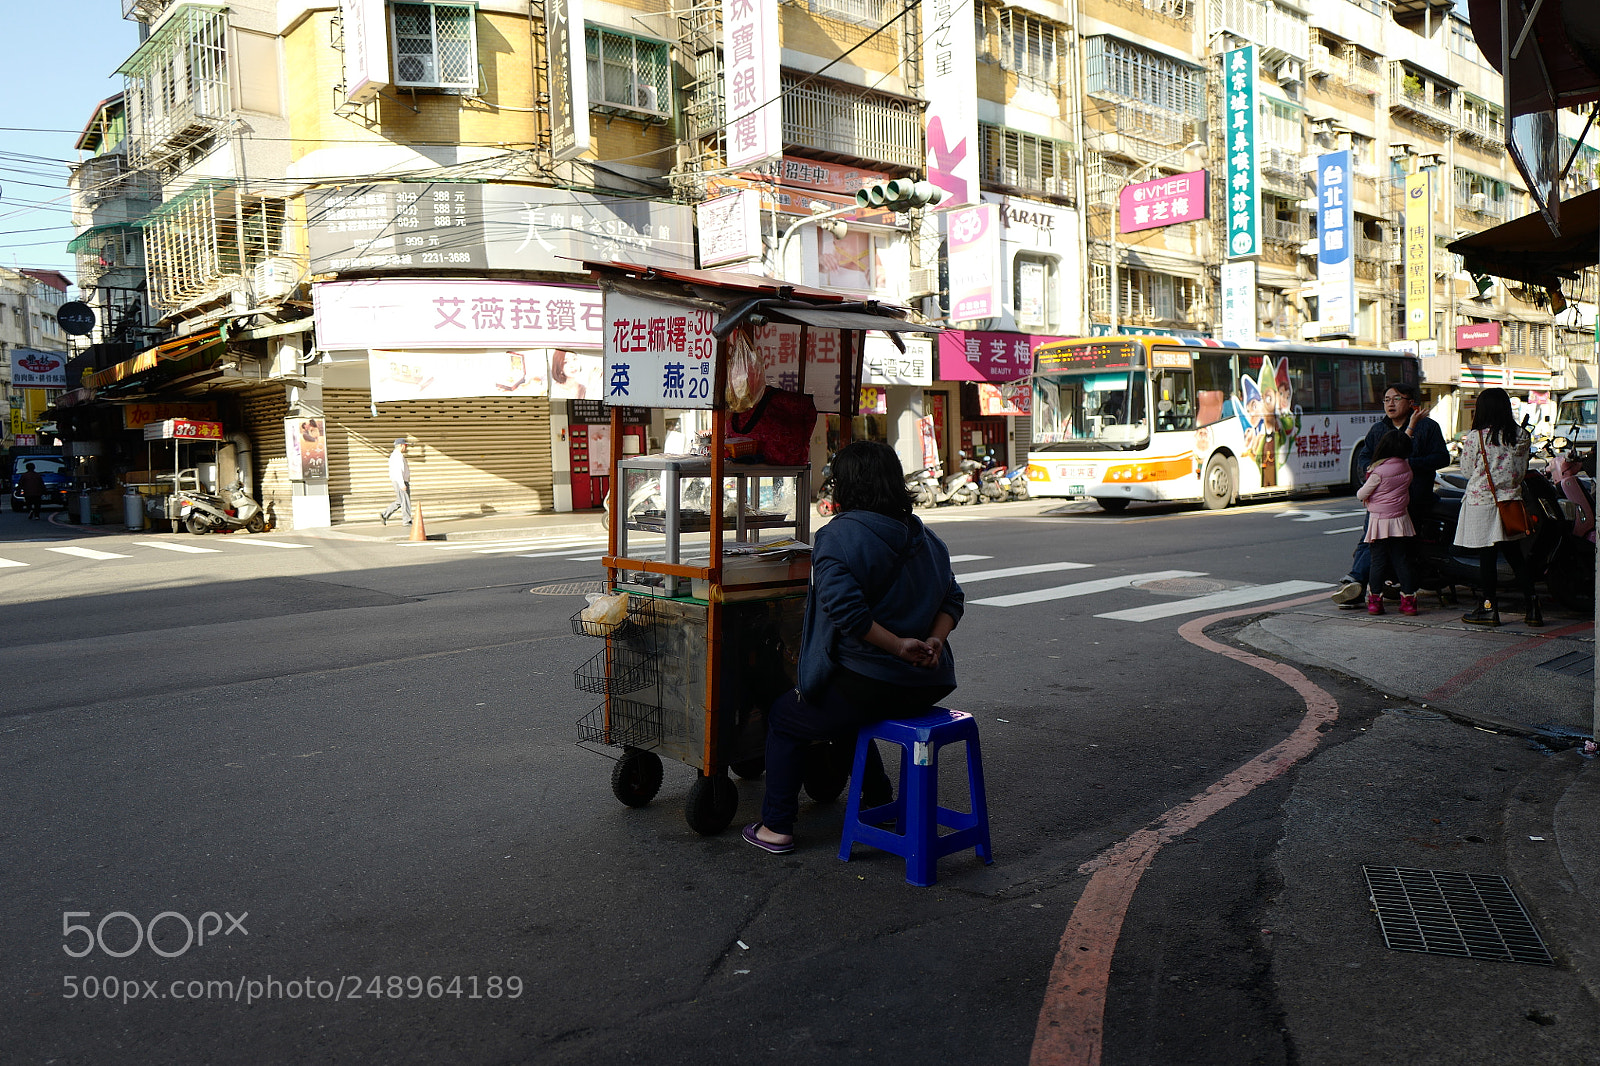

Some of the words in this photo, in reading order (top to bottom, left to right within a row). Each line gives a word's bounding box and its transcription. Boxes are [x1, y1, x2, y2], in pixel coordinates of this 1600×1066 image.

[1000, 202, 1056, 229] KARATE
[1134, 197, 1190, 224] 喜芝梅
[694, 310, 714, 336] 30
[694, 338, 712, 360] 50
[964, 338, 1031, 365] 喜芝梅
[690, 362, 710, 375] 一個
[990, 367, 1012, 376] BEAUTY
[688, 378, 710, 398] 20
[176, 422, 197, 436] 373
[198, 424, 221, 438] 海產
